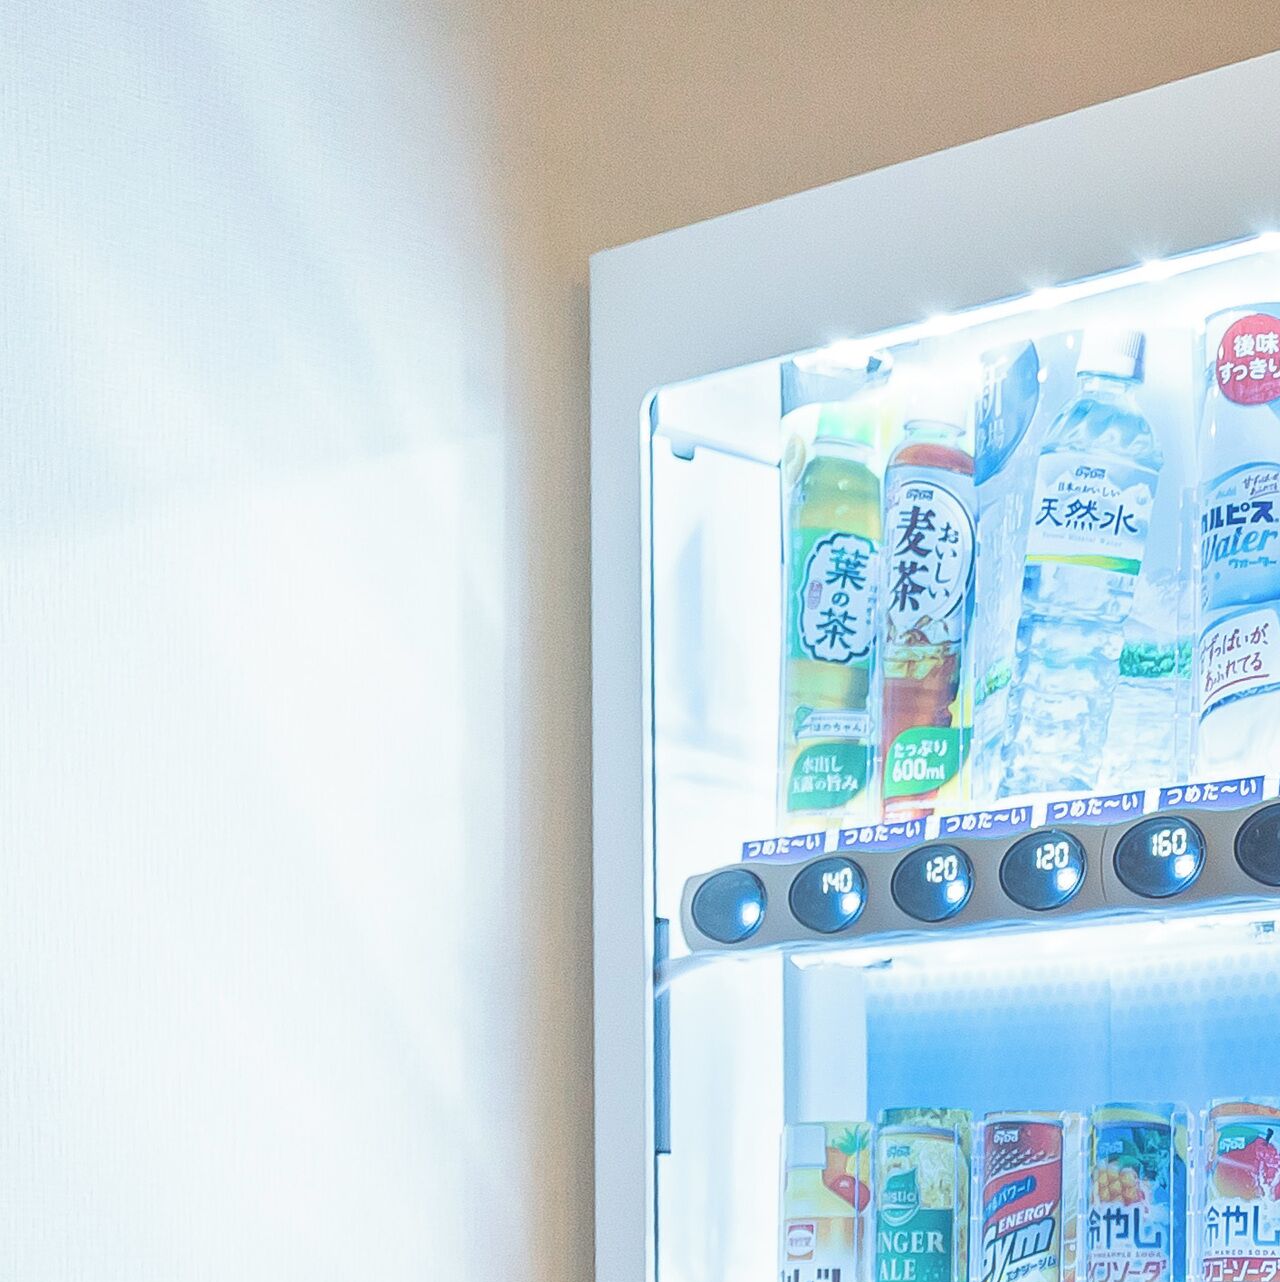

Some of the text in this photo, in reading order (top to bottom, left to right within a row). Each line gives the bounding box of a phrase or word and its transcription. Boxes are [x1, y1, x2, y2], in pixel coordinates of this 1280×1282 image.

[1233, 331, 1280, 358] 後味
[1034, 497, 1138, 535] 天然水
[887, 505, 937, 612] 麦茶
[926, 521, 960, 601] おいしい
[815, 546, 870, 650] 葉の茶
[894, 739, 948, 760] たっぷり
[893, 758, 946, 783] 600ml
[1035, 841, 1070, 870] 120
[1151, 827, 1187, 858] 160
[822, 867, 854, 894] 140
[926, 854, 959, 884] 120
[998, 1199, 1054, 1234] ENERGY
